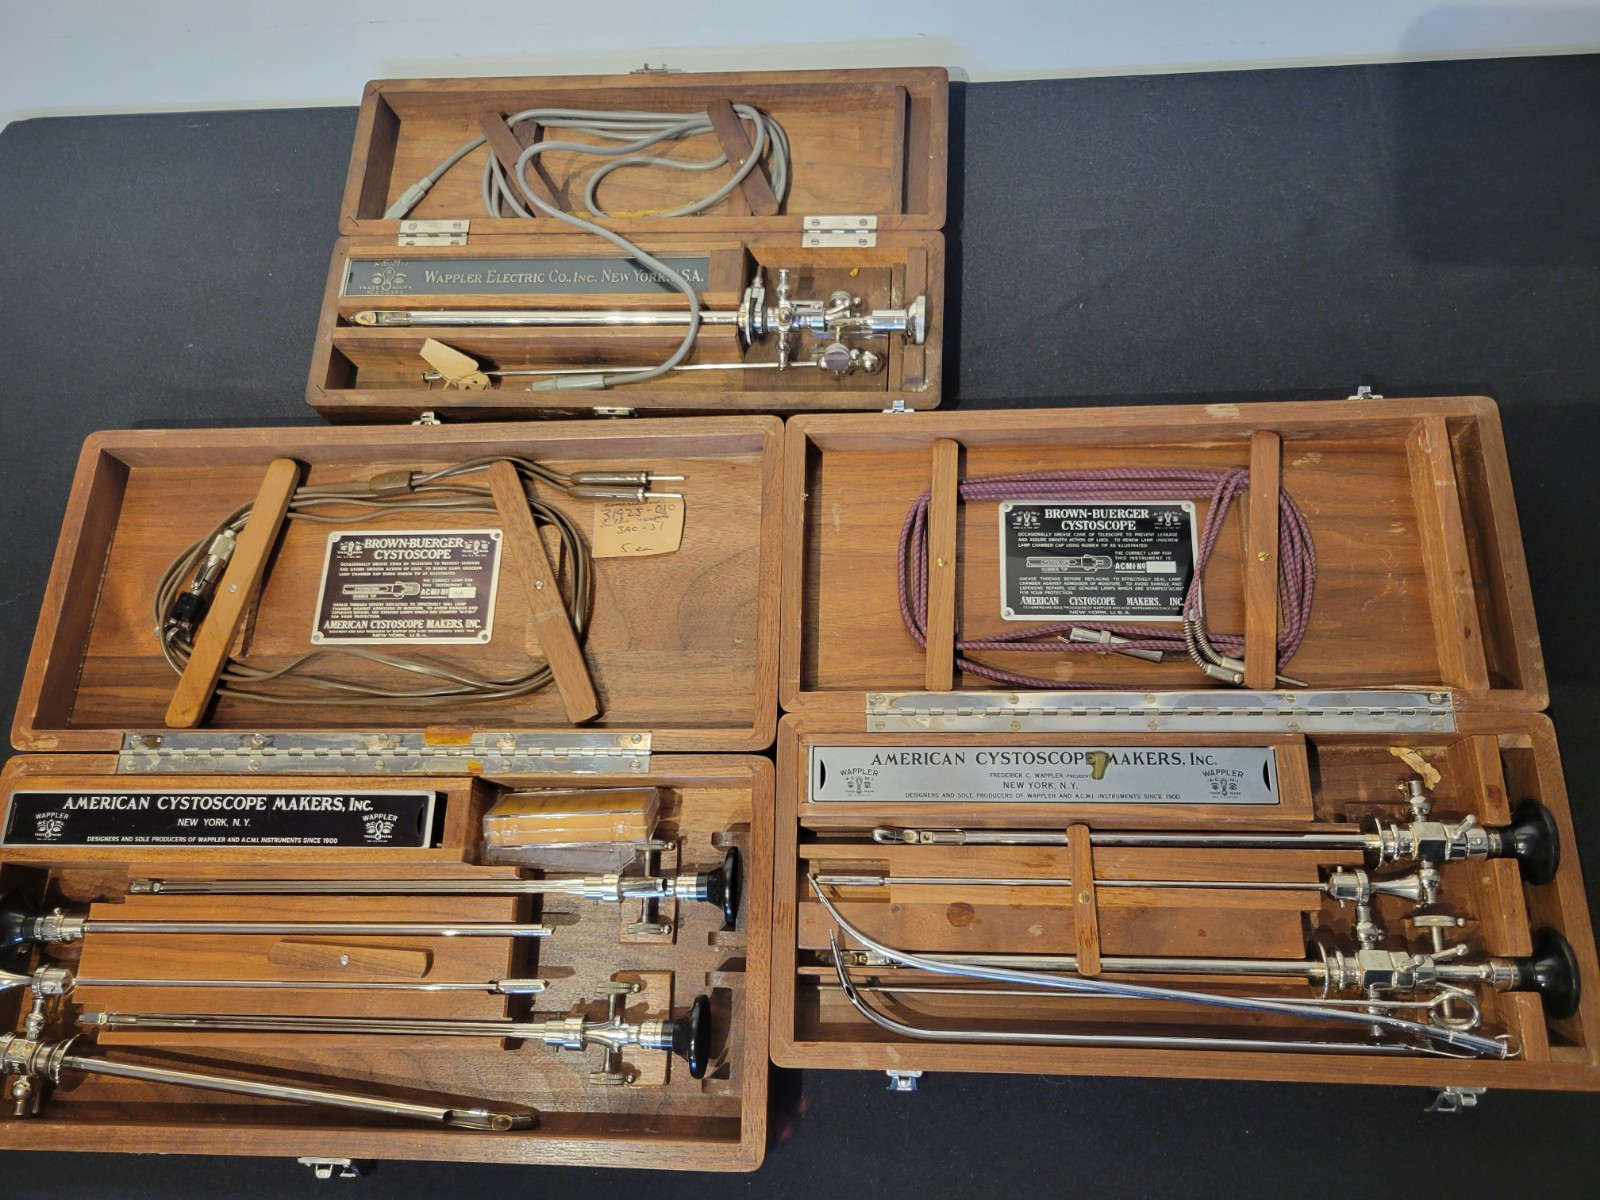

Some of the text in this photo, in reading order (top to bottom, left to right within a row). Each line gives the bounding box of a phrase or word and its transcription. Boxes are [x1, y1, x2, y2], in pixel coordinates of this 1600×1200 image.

[1044, 509, 1149, 518] BROWN-BUERGER
[1061, 520, 1136, 531] CYSTOSCOPE
[364, 537, 464, 549] BROWN-BUERGER
[374, 549, 452, 560] CYSTOSCOPE
[1020, 596, 1059, 606] AMERICAN
[1069, 596, 1116, 606] CYSTOSCOPE
[324, 620, 369, 629] AMERICAN
[370, 620, 425, 629] CYSTOSCOPE
[870, 752, 965, 765] AMERICAN
[976, 751, 1096, 765] CYSTOSCOPE
[840, 768, 879, 777] WAPPLER
[1202, 768, 1244, 778] WAPPLER
[1003, 782, 1025, 790] NEW
[62, 796, 374, 812] AMERICAN CYSTOSCOPE MAKERS, INC.
[35, 812, 70, 820] WAPPLER
[362, 813, 398, 822] WAPPLER
[177, 818, 199, 827] NEW
